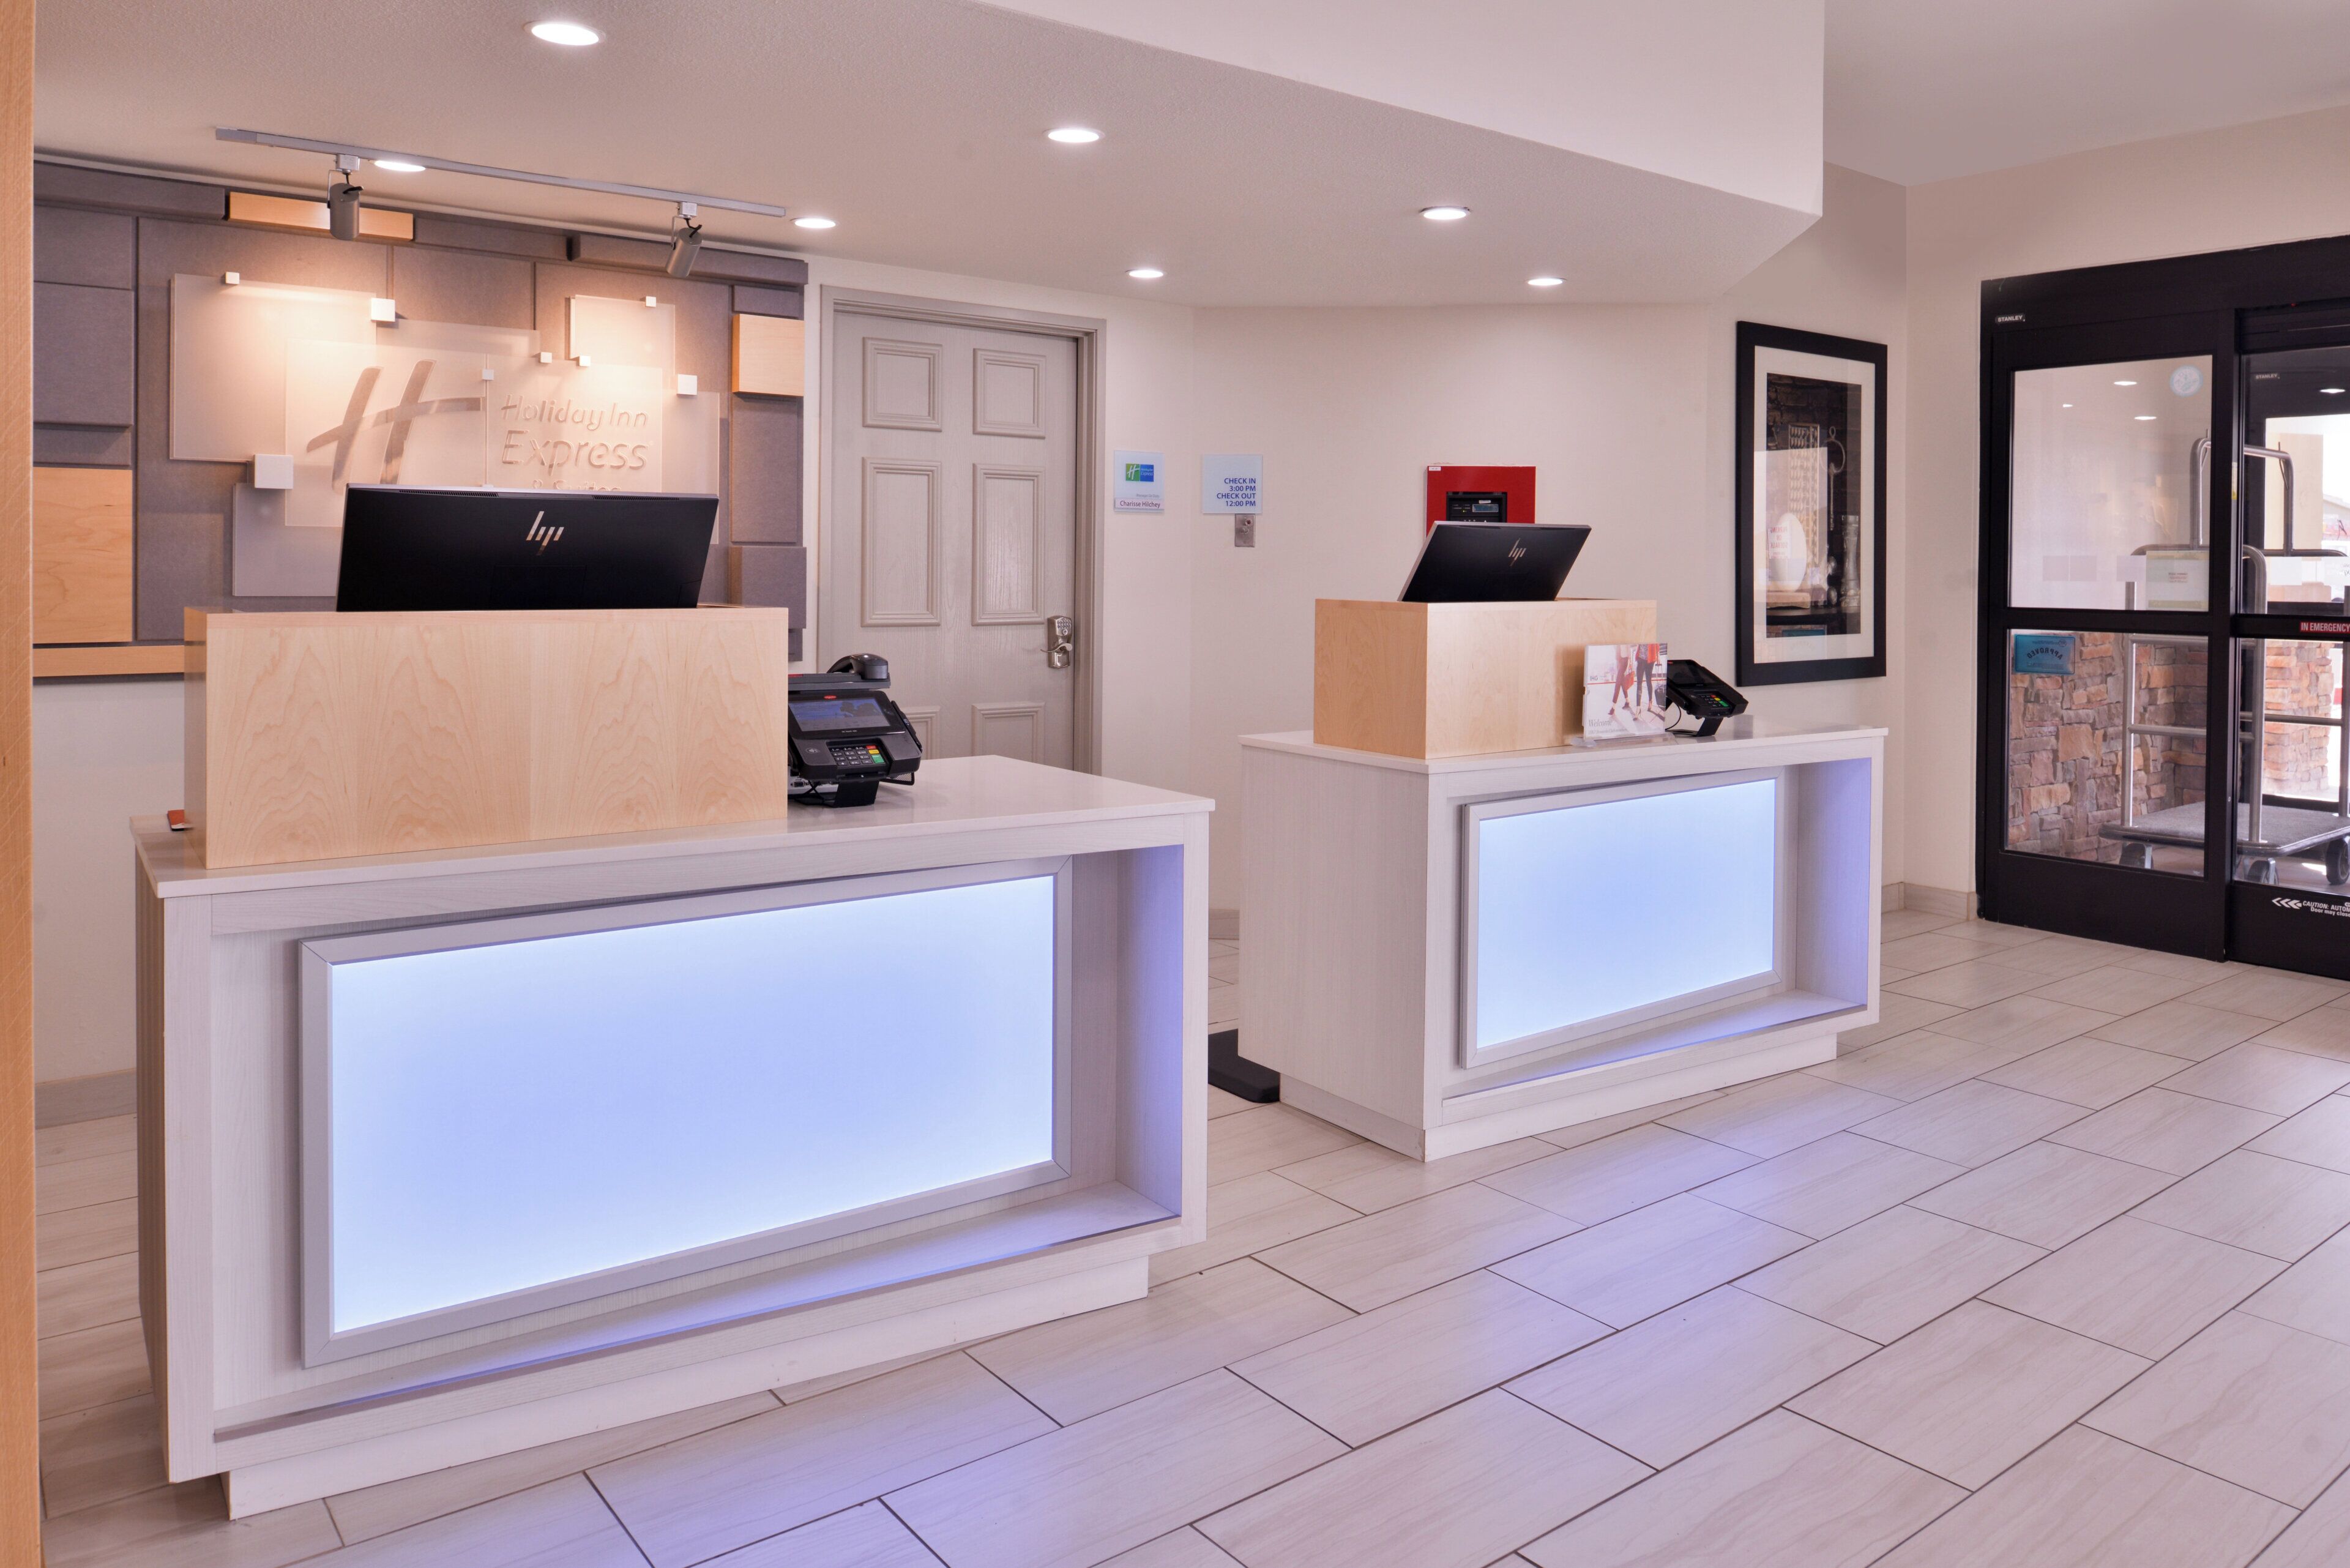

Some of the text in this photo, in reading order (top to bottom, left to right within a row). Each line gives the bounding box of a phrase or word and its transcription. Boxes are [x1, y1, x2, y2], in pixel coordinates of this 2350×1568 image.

[501, 394, 650, 431] Holiday Inn
[501, 430, 649, 476] Express
[2300, 622, 2350, 632] IN EMERGENCY
[1588, 719, 1613, 727] Welcome
[2302, 900, 2329, 909] CAUTION:
